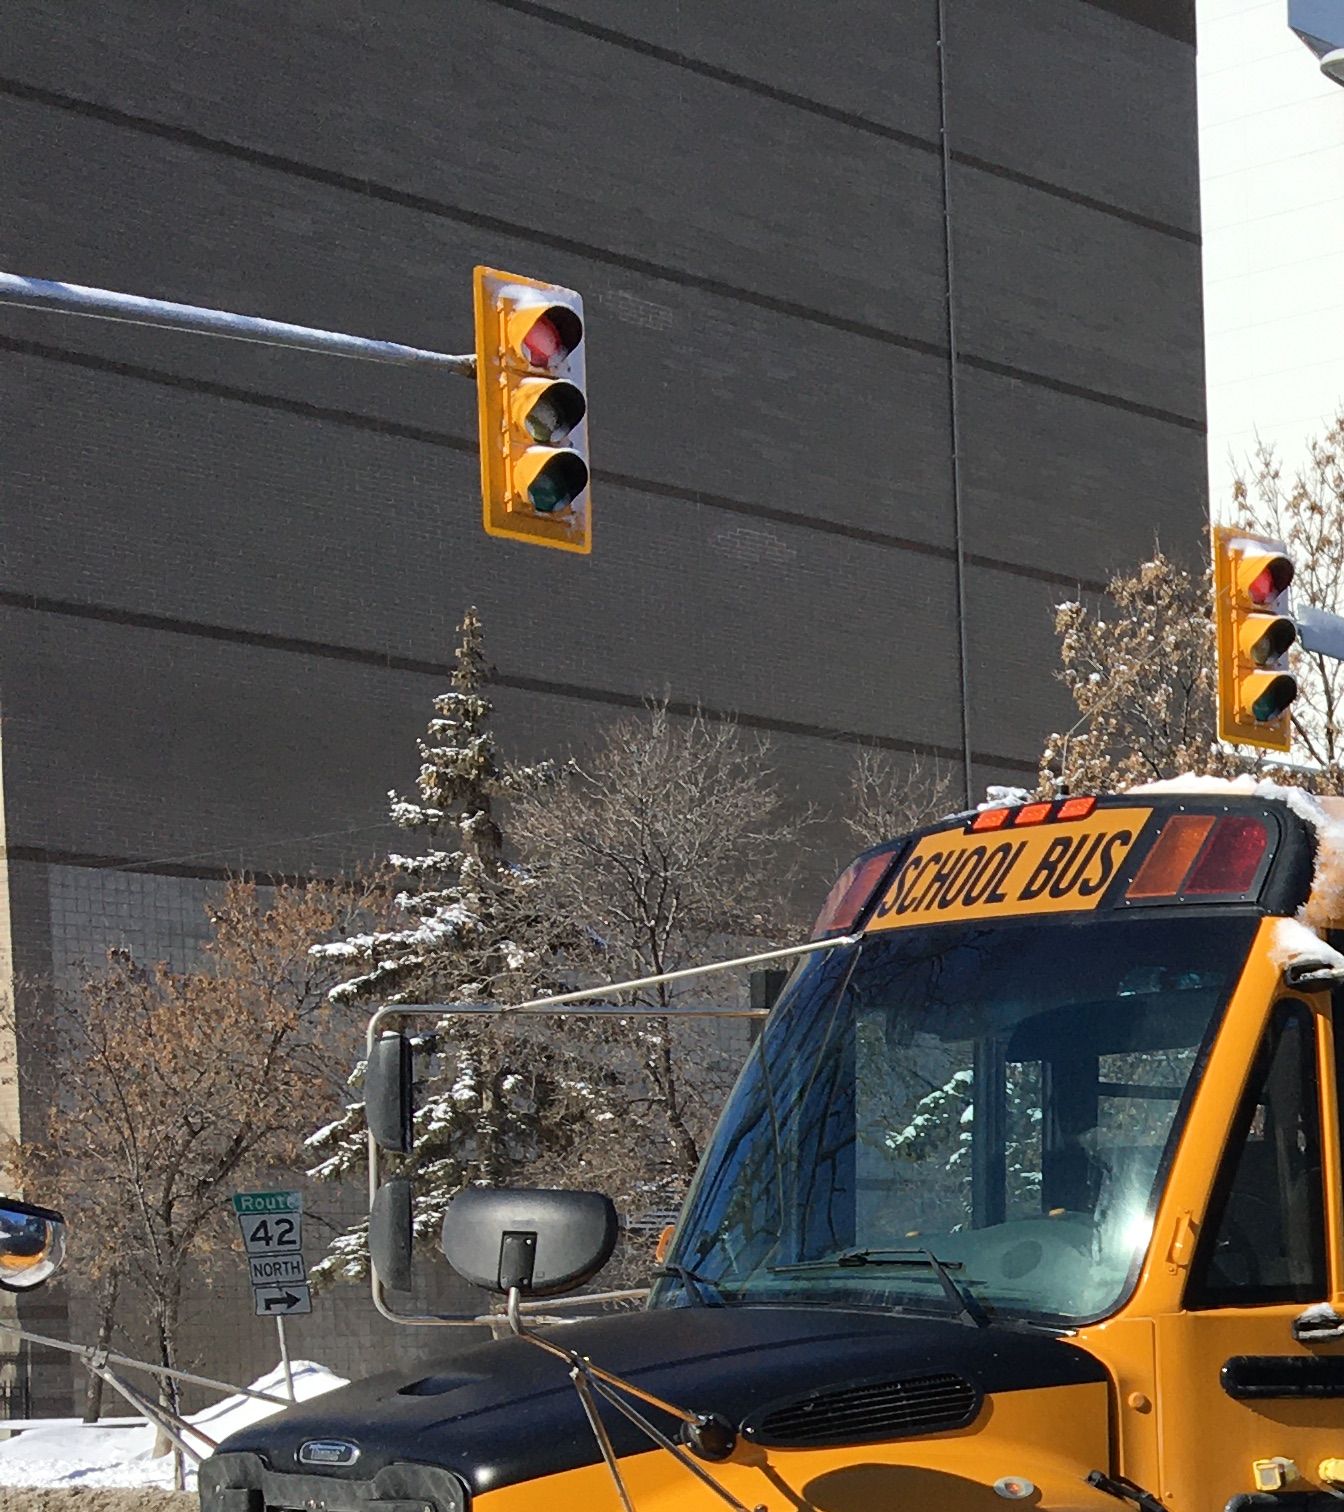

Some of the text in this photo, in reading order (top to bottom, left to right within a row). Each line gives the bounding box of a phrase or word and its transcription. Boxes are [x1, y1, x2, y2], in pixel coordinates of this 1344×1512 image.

[877, 829, 1132, 919] SCHOOL BUS
[250, 1218, 297, 1246] 42
[253, 1261, 301, 1277] NORTH
